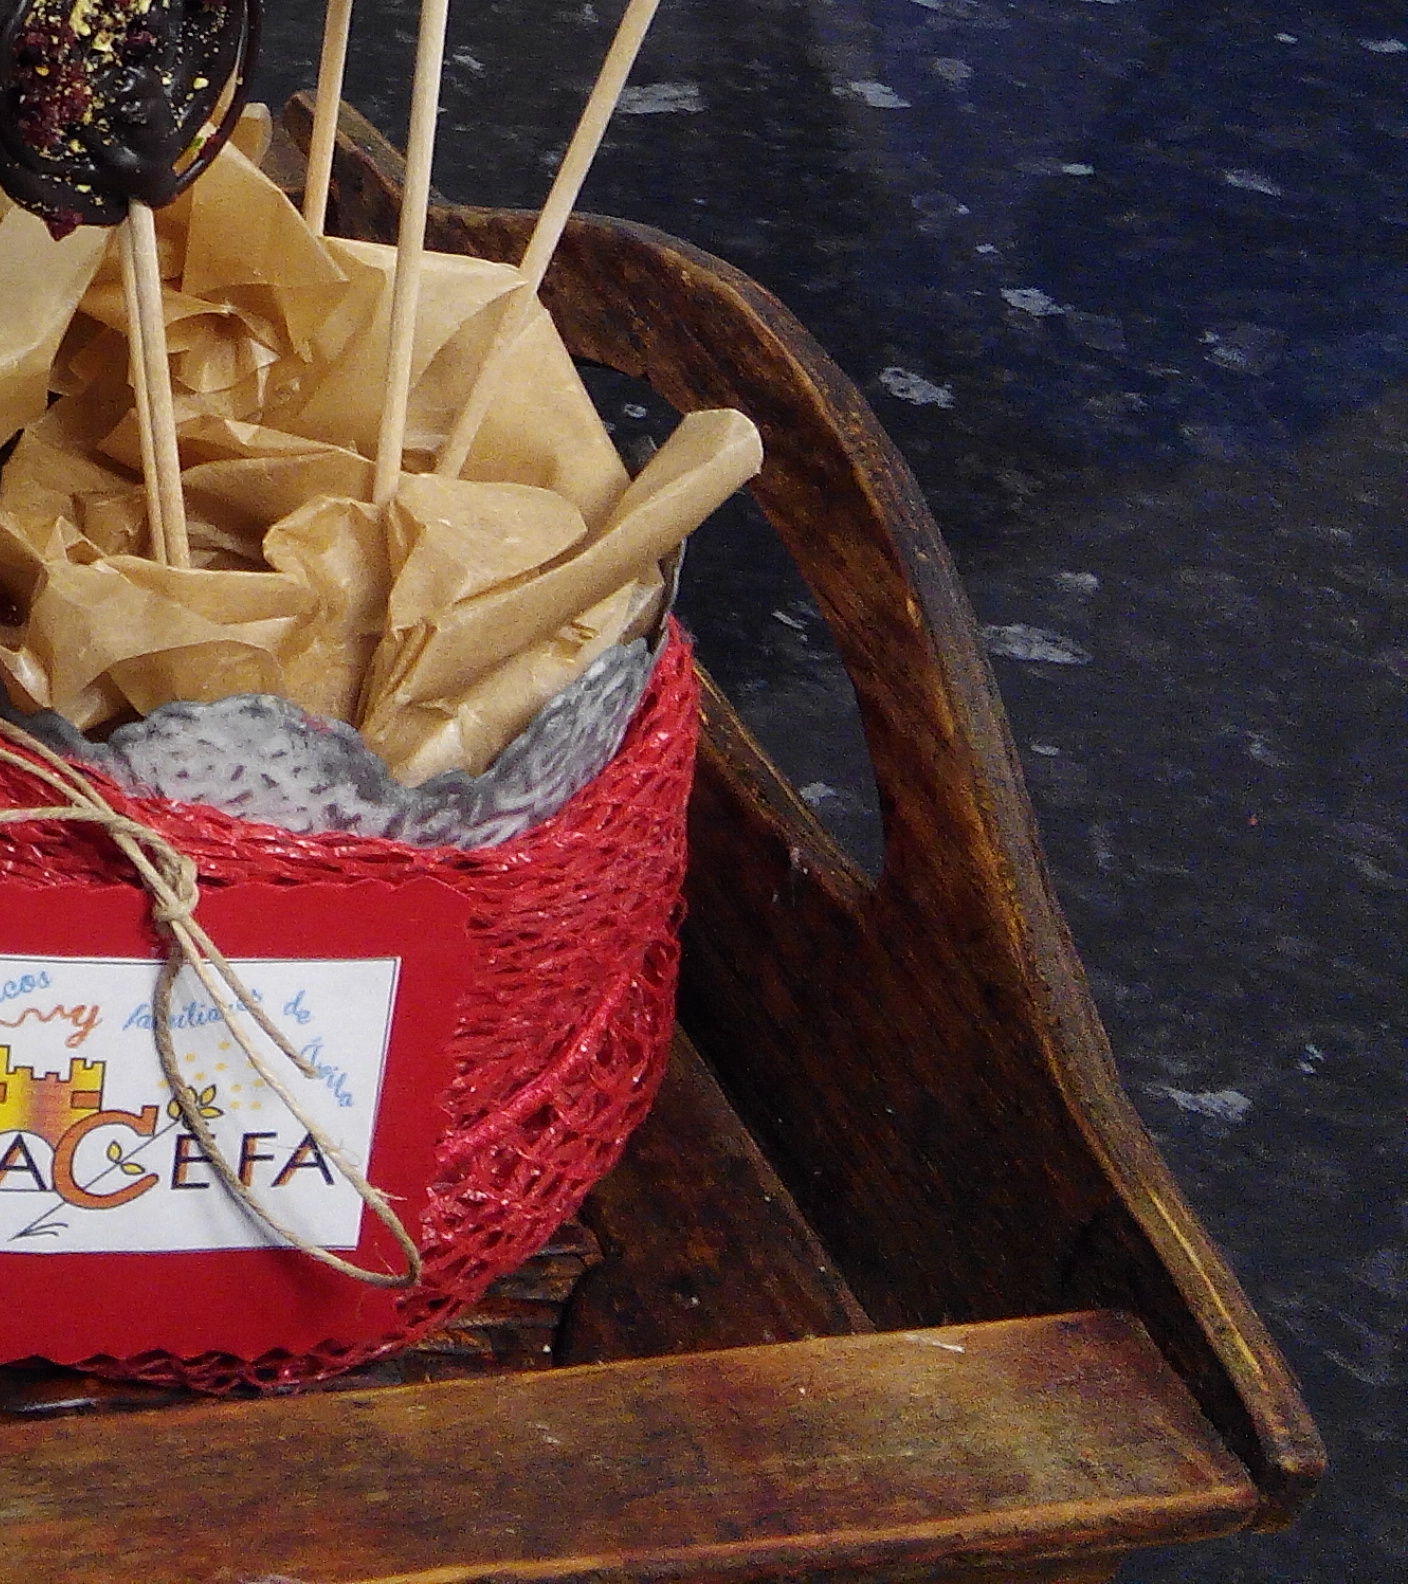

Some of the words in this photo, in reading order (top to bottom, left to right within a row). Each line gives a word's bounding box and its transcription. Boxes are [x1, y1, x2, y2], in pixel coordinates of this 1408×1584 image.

[64, 1003, 101, 1049] y
[122, 988, 264, 1031] failiaes
[284, 989, 312, 1025] de
